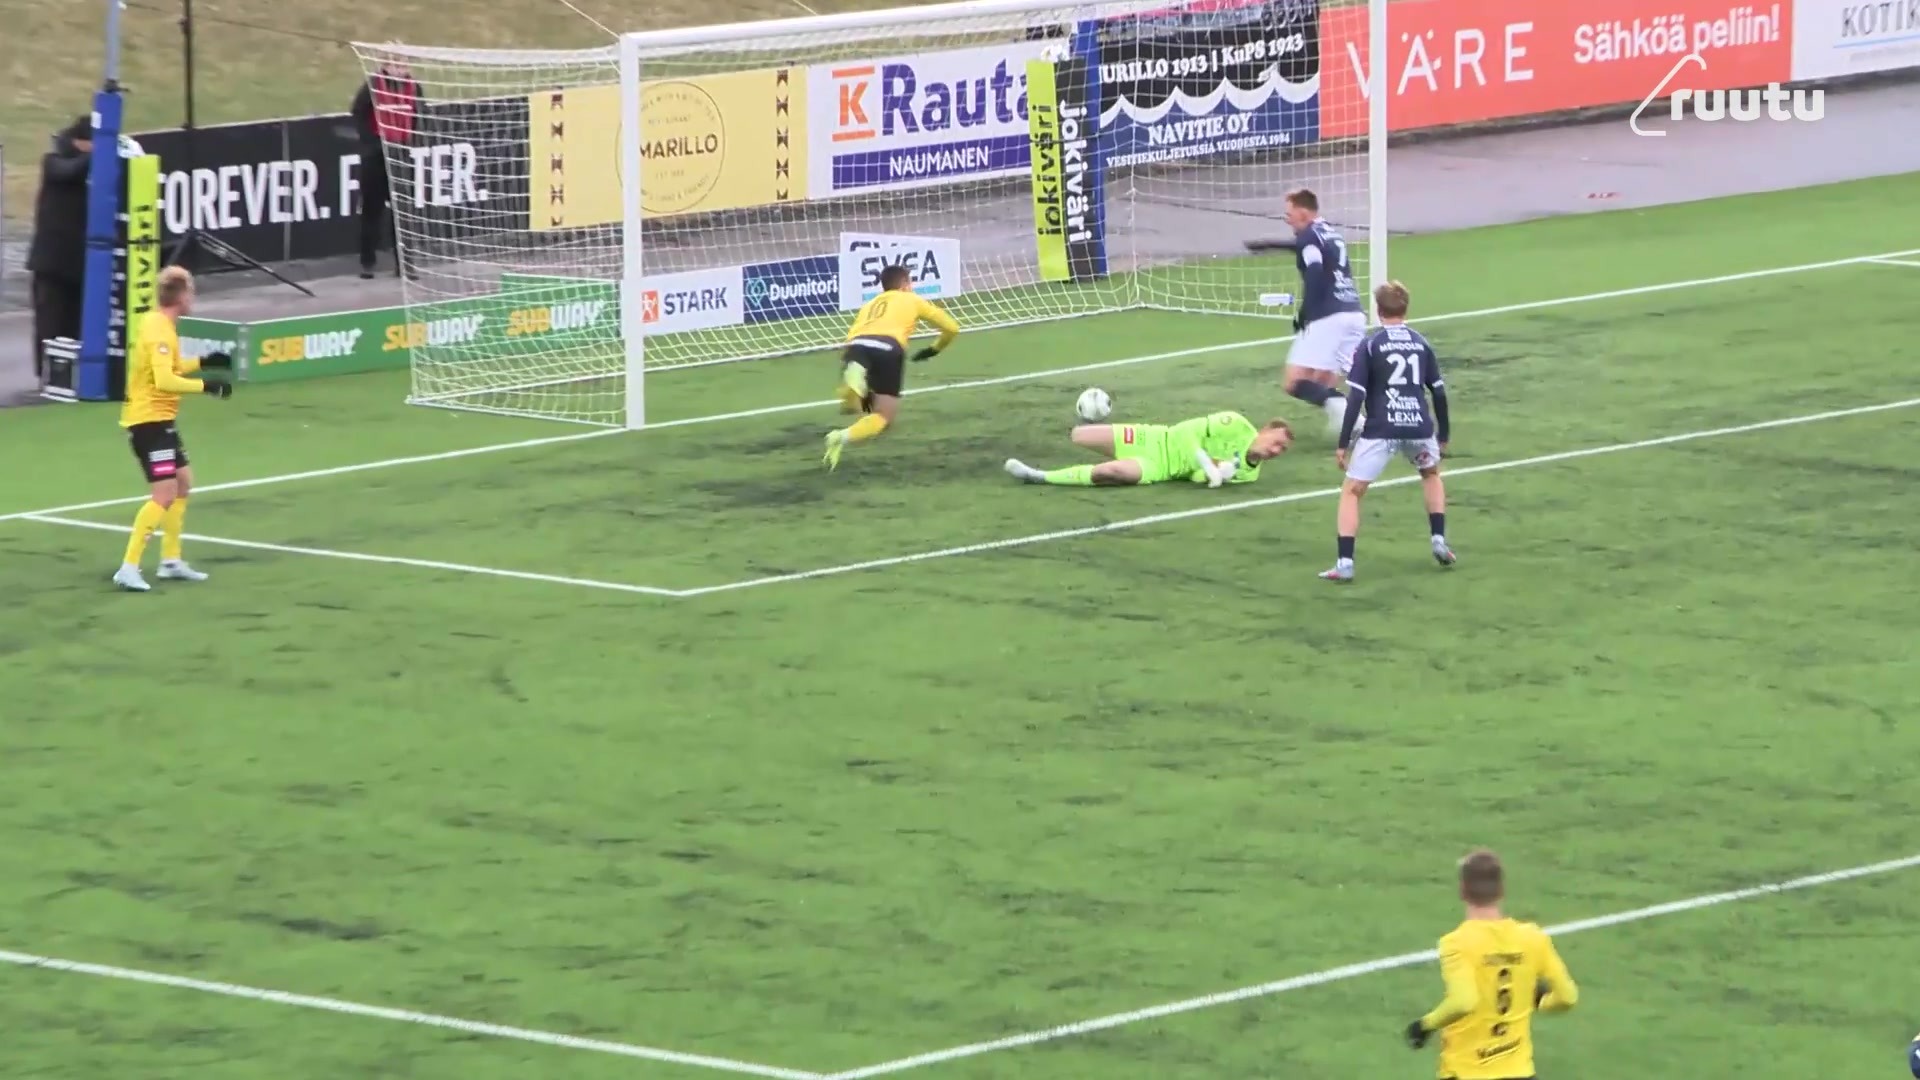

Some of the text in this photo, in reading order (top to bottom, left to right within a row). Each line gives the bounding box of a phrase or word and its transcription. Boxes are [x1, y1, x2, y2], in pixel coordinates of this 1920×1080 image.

[1573, 4, 1780, 63] Sähköä peliin!
[1099, 59, 1168, 83] URILLO
[1172, 55, 1208, 76] 1913
[1268, 33, 1304, 57] 1923
[1149, 112, 1253, 146] NAVITIE OY
[640, 133, 719, 160] MARILLO
[889, 145, 989, 177] NAUMANEN
[1059, 100, 1092, 243] jokiväri
[664, 287, 728, 315] STARK
[769, 275, 839, 299] Duunitori
[382, 314, 484, 350] SUBWAY
[507, 300, 605, 336] SUBWAY
[258, 327, 363, 365] SUBWAY
[1386, 353, 1421, 386] 21
[1387, 411, 1424, 423] LEXIA
